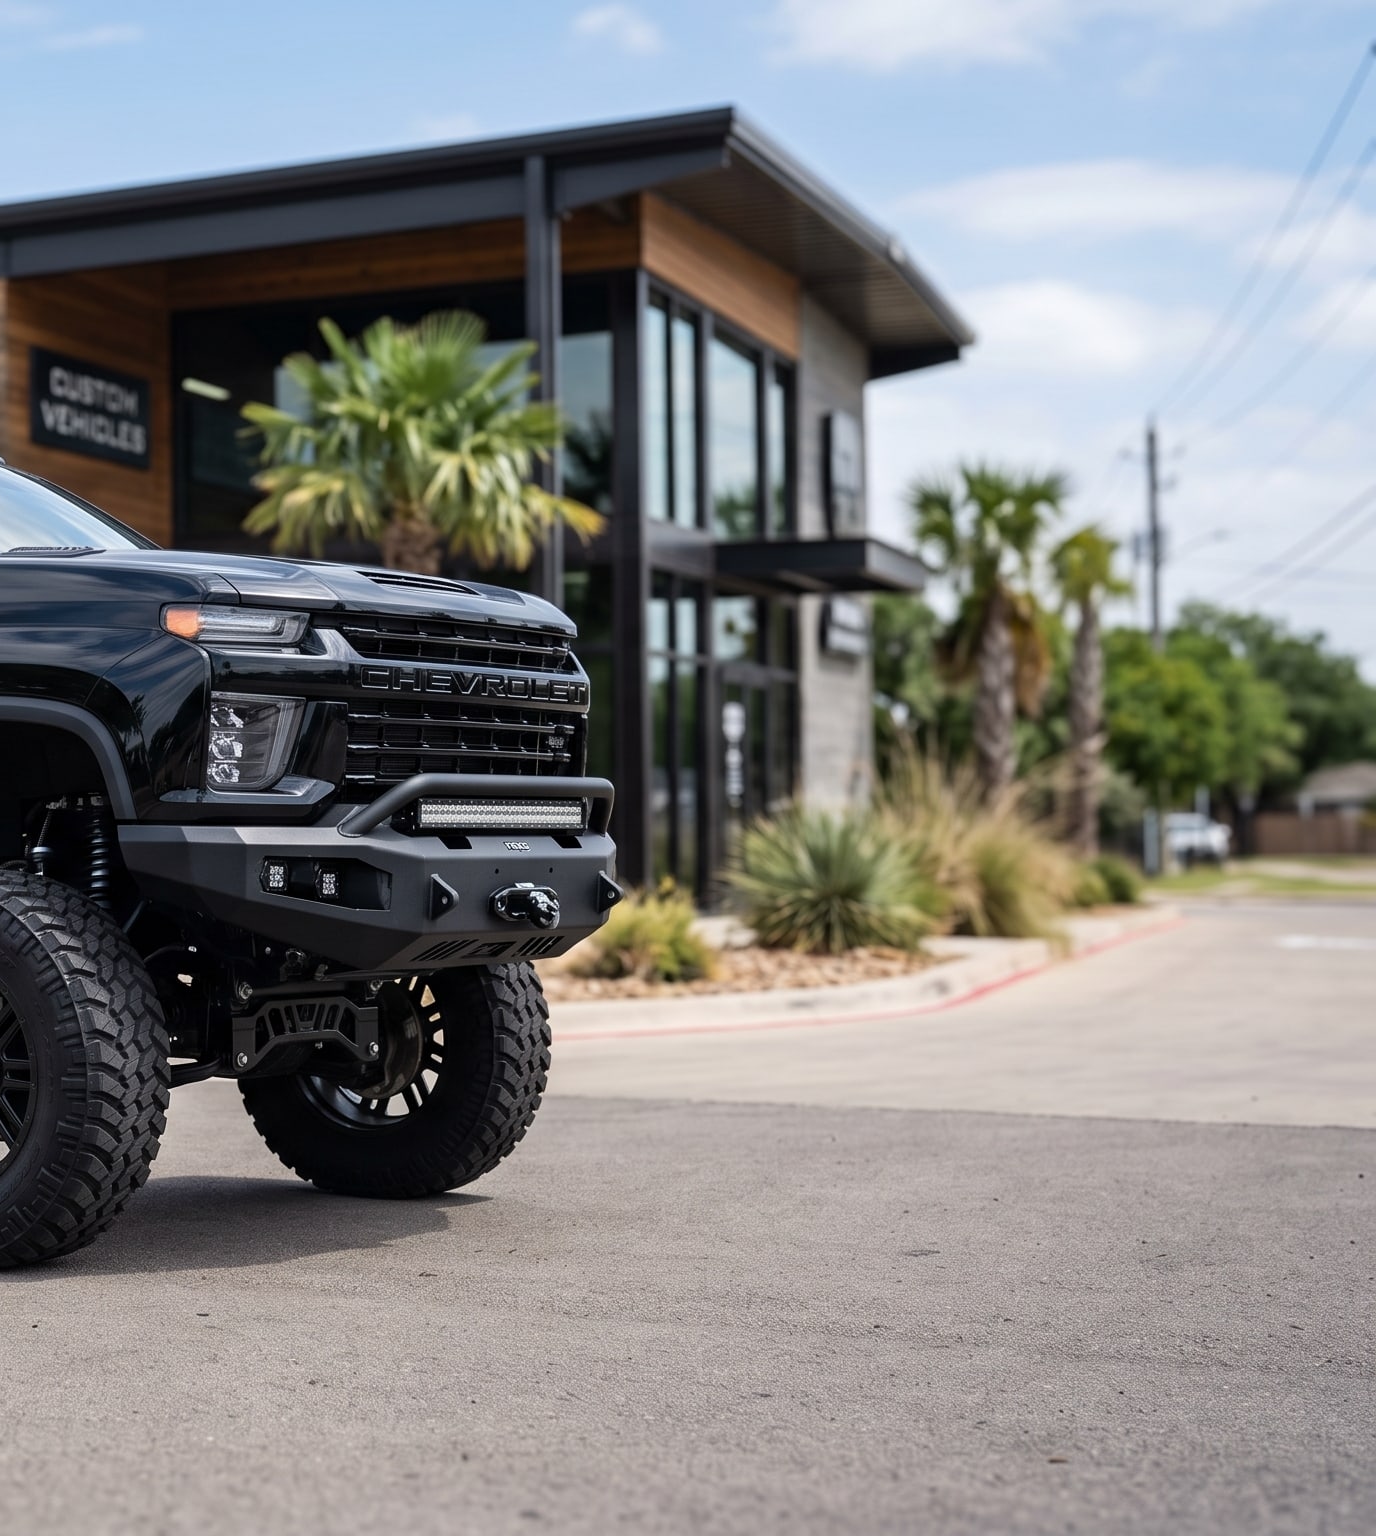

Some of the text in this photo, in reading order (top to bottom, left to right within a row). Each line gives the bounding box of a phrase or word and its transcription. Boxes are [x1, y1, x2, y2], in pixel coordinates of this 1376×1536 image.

[50, 366, 138, 415] CUSTOM
[41, 399, 146, 453] VEHICLES
[360, 666, 587, 703] CHEVROLET
